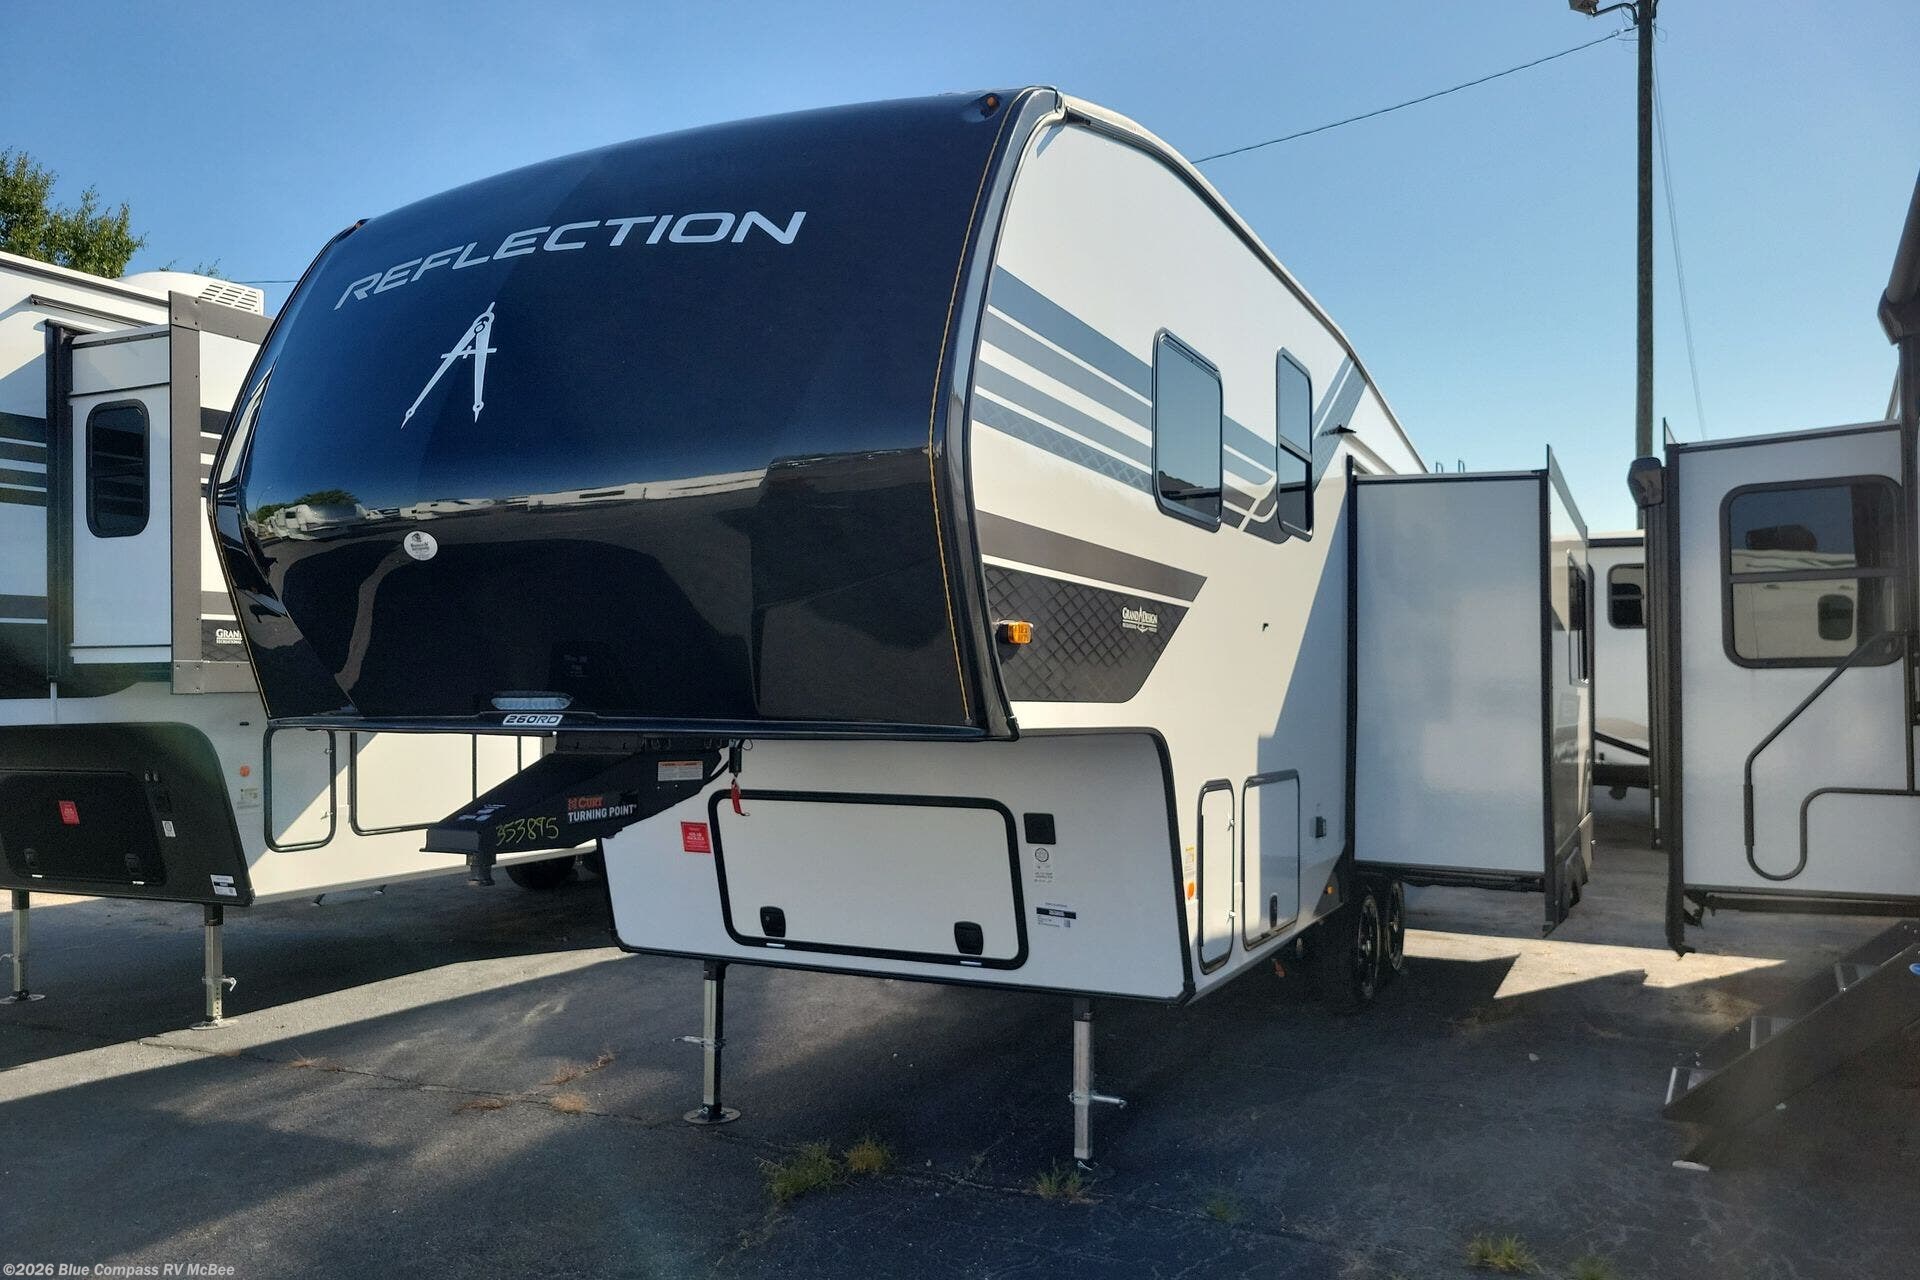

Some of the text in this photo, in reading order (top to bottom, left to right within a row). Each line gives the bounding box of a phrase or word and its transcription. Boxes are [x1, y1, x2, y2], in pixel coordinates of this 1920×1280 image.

[334, 211, 807, 311] REFLECTION
[216, 628, 242, 638] GRAN
[568, 804, 634, 823] TURNING POINT
